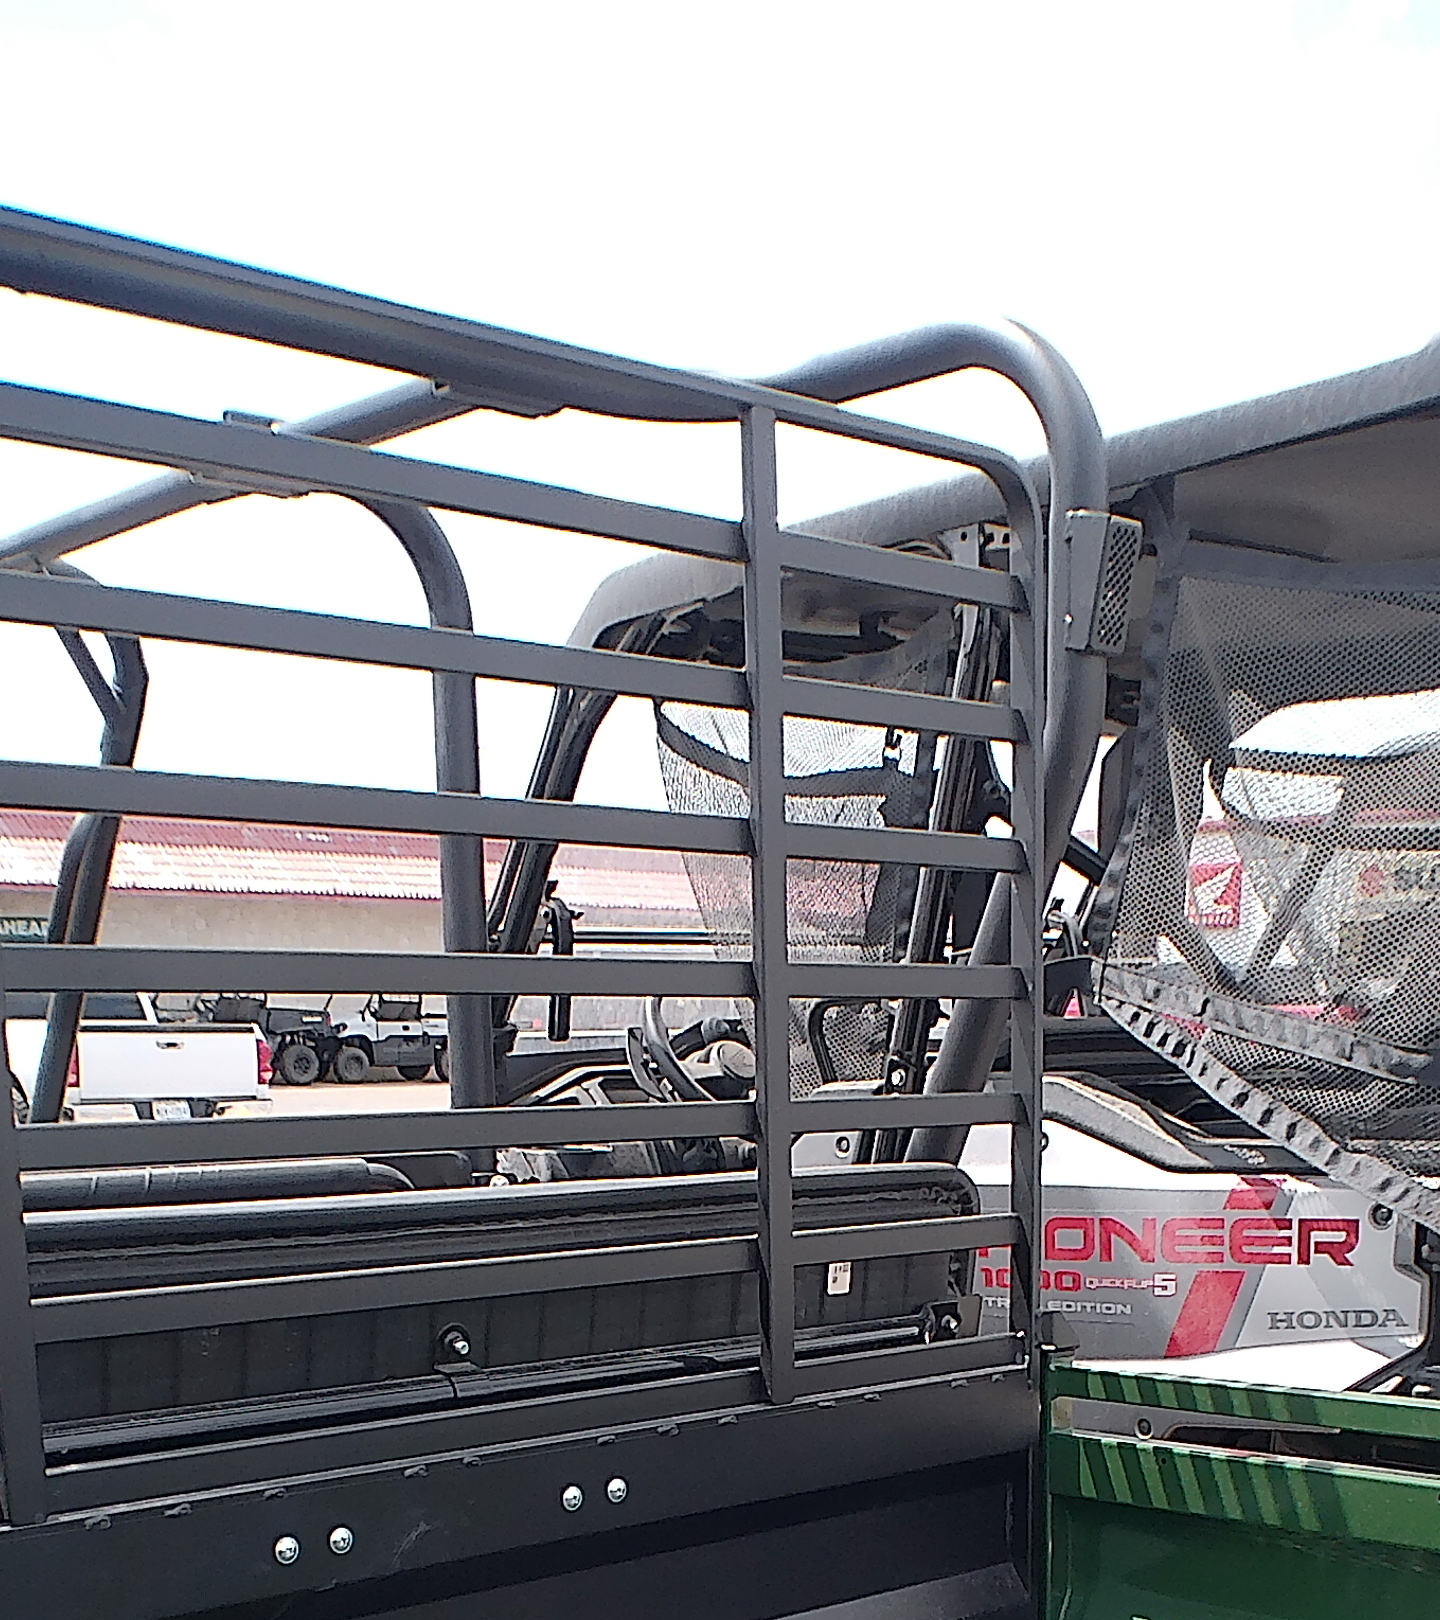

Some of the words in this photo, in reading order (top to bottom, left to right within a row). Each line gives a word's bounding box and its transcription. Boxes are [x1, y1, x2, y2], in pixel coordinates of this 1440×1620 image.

[978, 1216, 1360, 1267] ONEER
[1047, 1300, 1132, 1315] EDITION
[1266, 1309, 1409, 1332] HONDA
